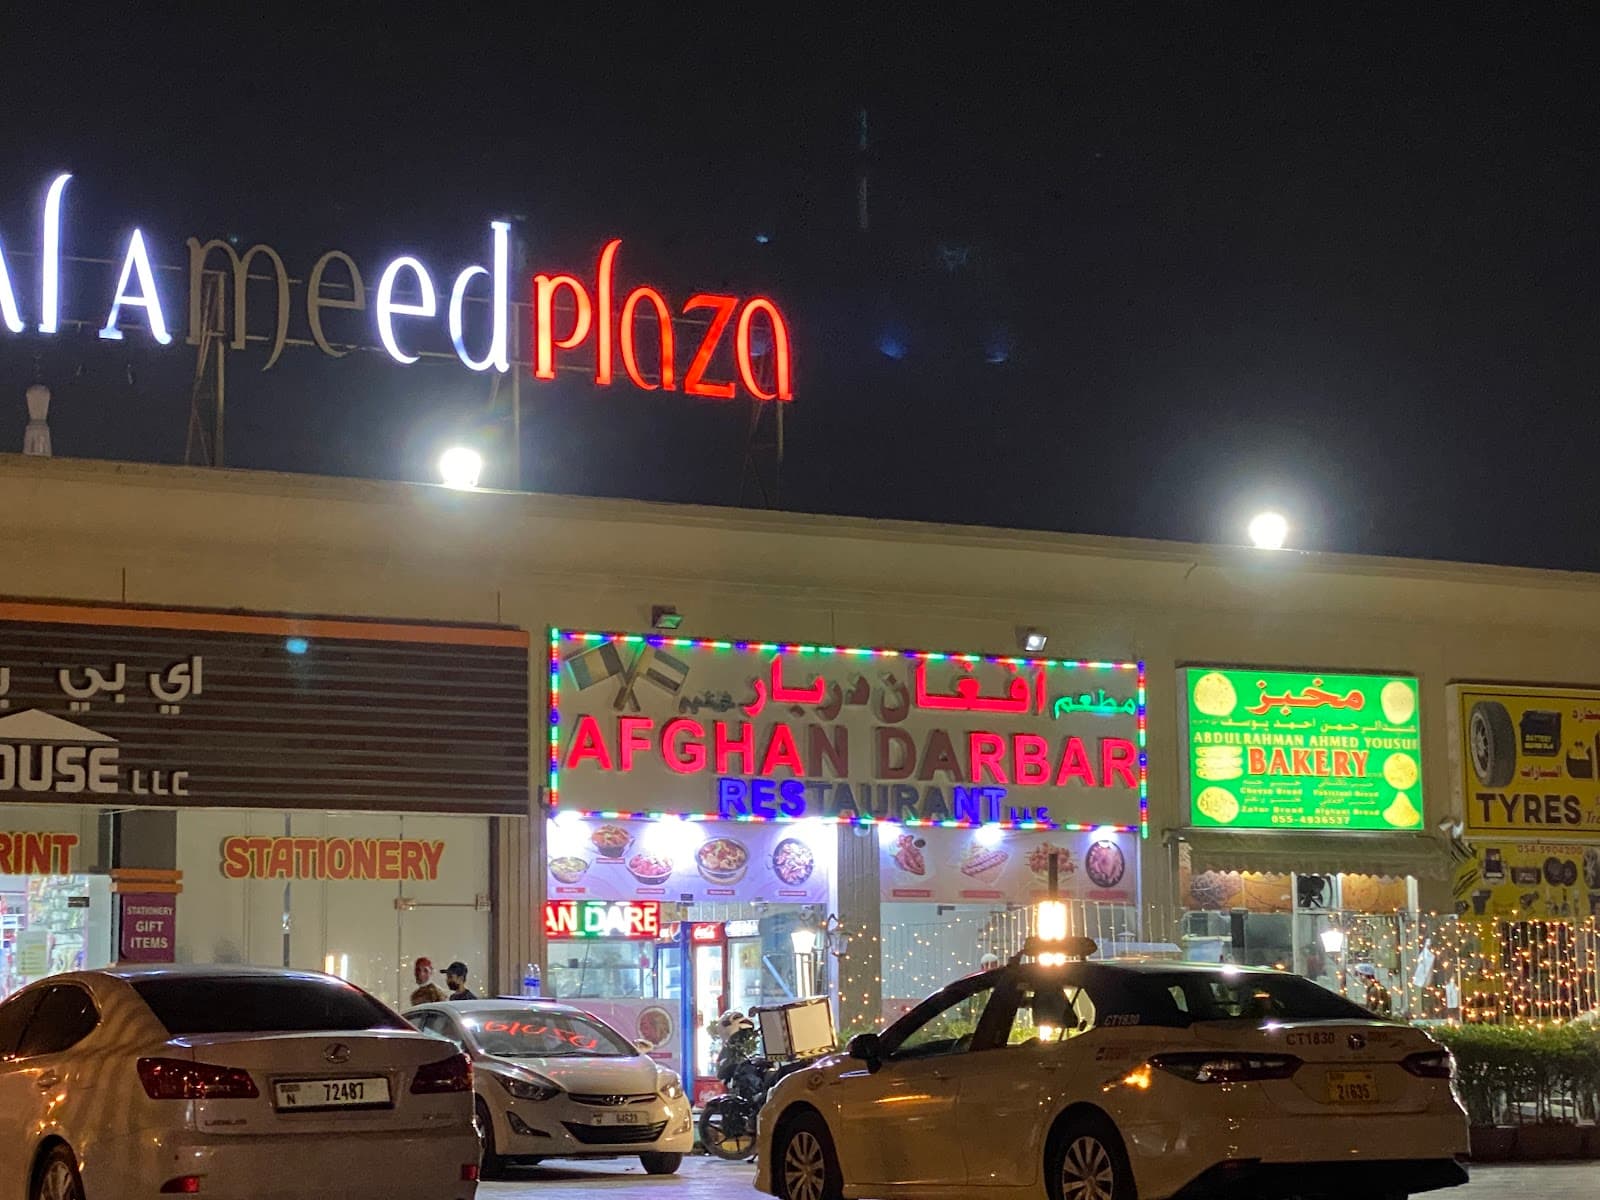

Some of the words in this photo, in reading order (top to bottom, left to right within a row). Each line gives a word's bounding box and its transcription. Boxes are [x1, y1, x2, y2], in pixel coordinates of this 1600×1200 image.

[533, 238, 794, 401] plaza
[1054, 688, 1137, 720] مطعم
[1243, 677, 1365, 715] مخبز
[566, 715, 849, 779] AFGHAN
[876, 726, 1139, 789] DARBAR
[1309, 735, 1360, 749] AHMED
[1247, 747, 1369, 778] BAKERY
[132, 769, 189, 797] LLC
[718, 777, 1008, 825] RESTAURANT
[1475, 792, 1582, 825] TYRES
[222, 835, 446, 881] STATIONERY
[126, 906, 173, 916] STATIONERY
[135, 920, 165, 933] GIFT
[130, 936, 169, 950] ITEMS
[1285, 1031, 1336, 1046] CT1830
[286, 1093, 297, 1105] N
[322, 1082, 364, 1102] 72487
